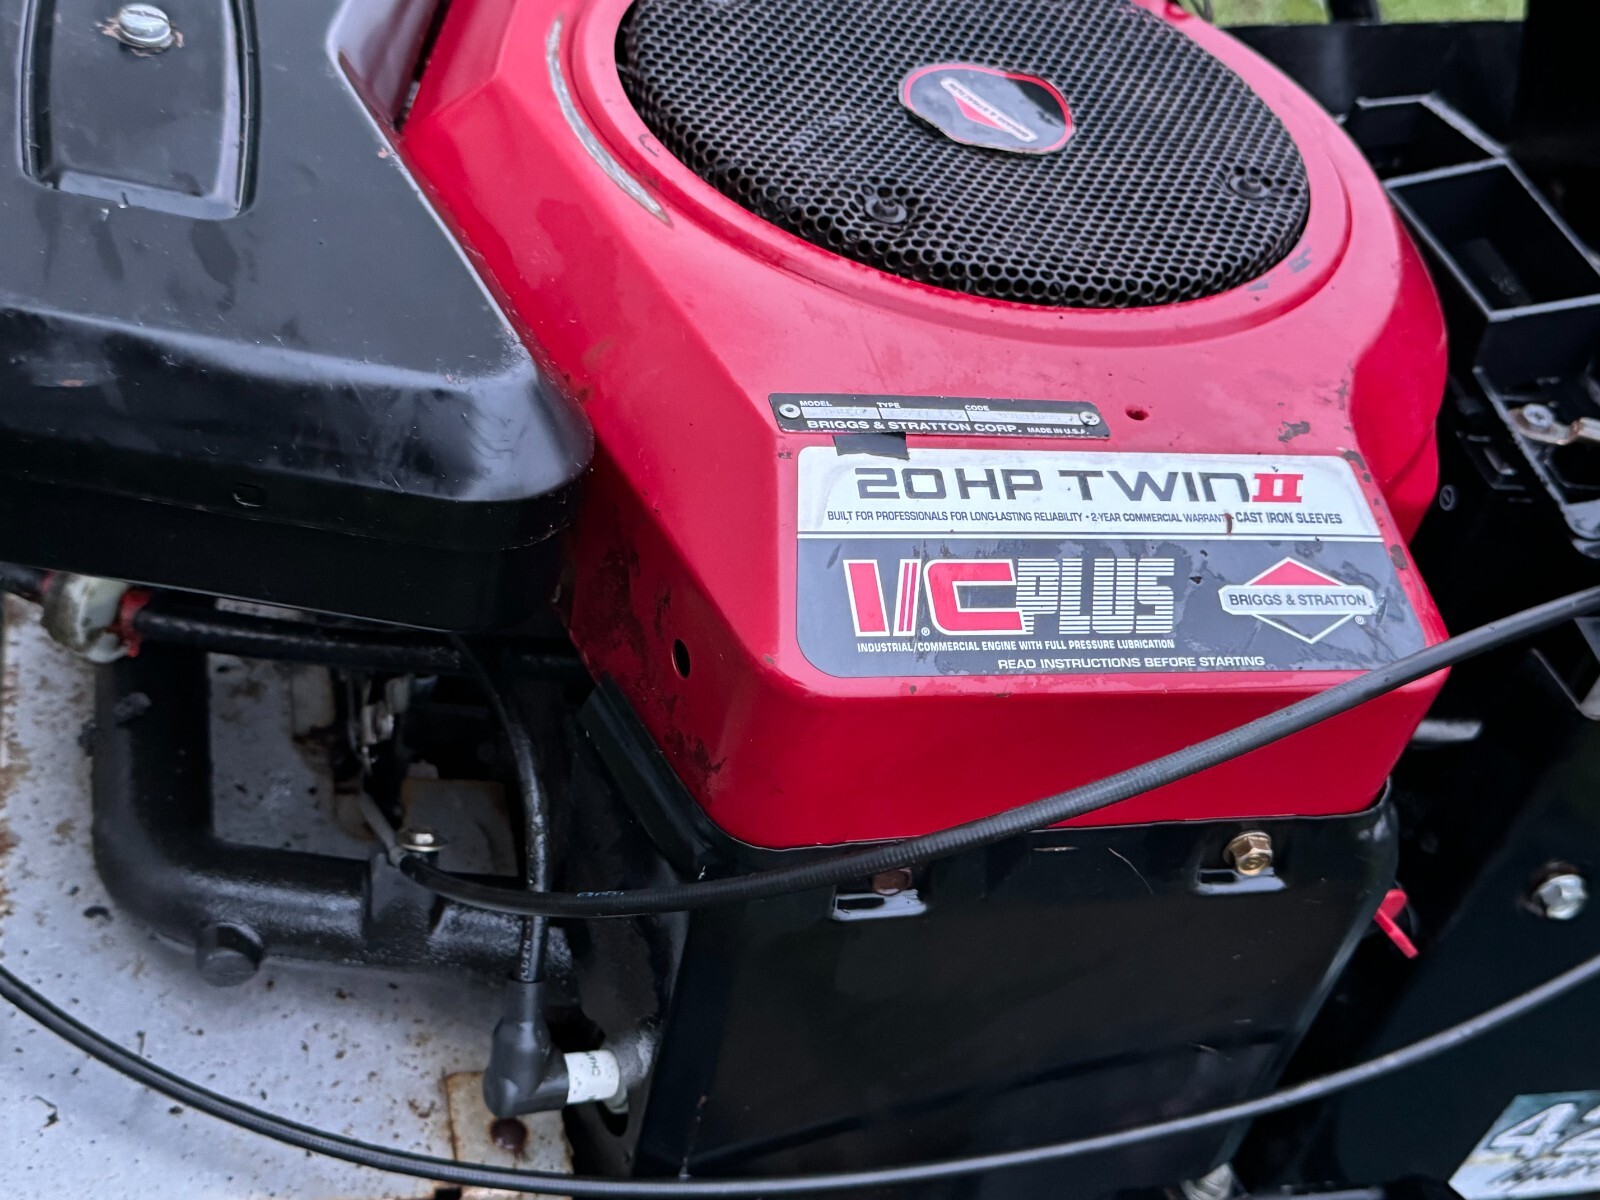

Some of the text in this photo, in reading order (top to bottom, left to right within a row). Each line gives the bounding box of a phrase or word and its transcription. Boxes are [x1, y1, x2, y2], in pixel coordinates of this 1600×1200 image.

[876, 401, 901, 409] TYPE
[964, 404, 990, 412] CODE
[806, 420, 870, 430] BRIGGS
[874, 421, 886, 430] &
[888, 421, 972, 432] STRATTON
[974, 424, 1022, 433] CORP.
[1053, 427, 1064, 435] IN
[854, 467, 947, 500] 20
[954, 468, 1043, 500] HP
[827, 511, 1343, 524] BUILT FOR PROFESSIONALS FOR LONG-LASTING RELIABILITY 2-YEAR COMMERCIAL WARRANT CAST IRON SLEEVES
[1015, 558, 1175, 635] PLUS
[1228, 594, 1367, 606] BRIGGS & STRATTON
[857, 638, 1175, 653] INDUSTRIAL/COMMERCIAL ENGINE WITH FULL PRESSURE LUBRICATION
[997, 656, 1266, 670] READ INSTRUCTIONS BEFORE STARTING
